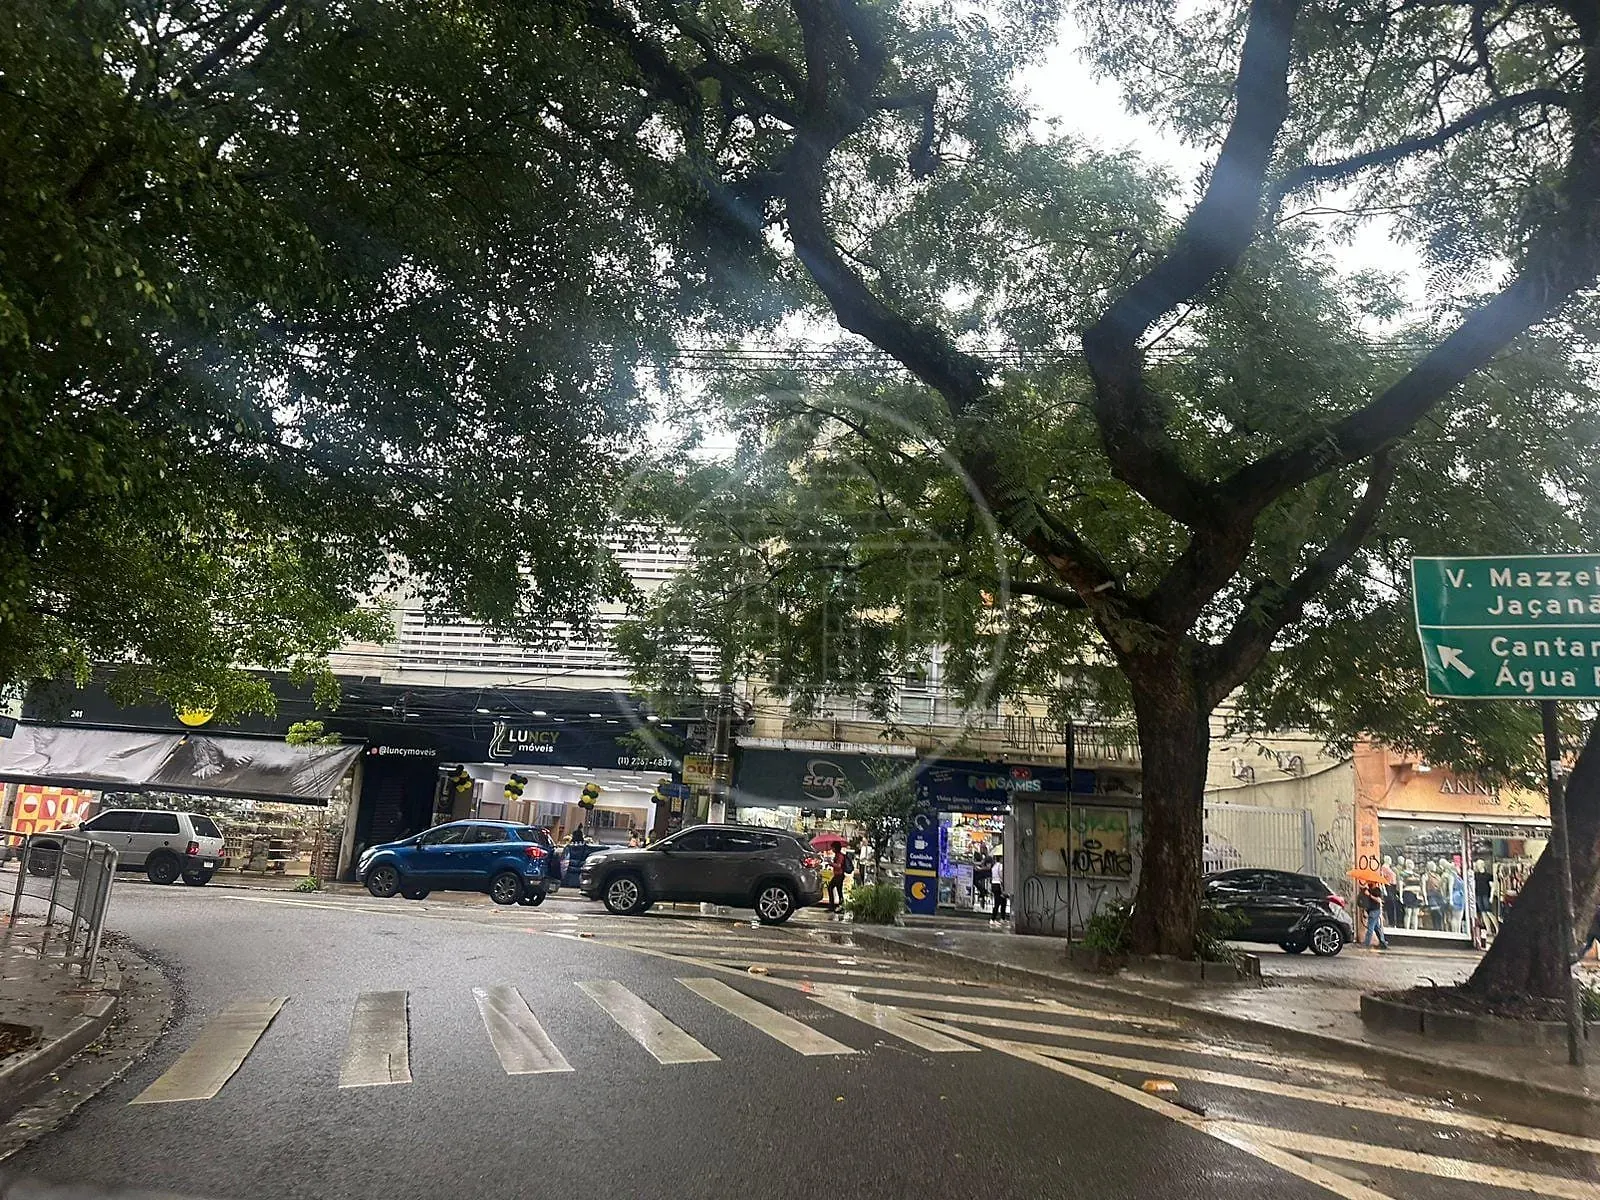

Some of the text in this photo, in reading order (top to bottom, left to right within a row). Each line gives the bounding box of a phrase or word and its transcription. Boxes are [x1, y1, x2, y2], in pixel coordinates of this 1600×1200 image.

[1446, 568, 1472, 588] V.
[1487, 594, 1600, 618] Jaçanã
[1495, 659, 1576, 692] Água
[509, 729, 560, 744] LUNCY
[379, 745, 437, 757] @luncymoveis
[518, 742, 554, 753] móveis
